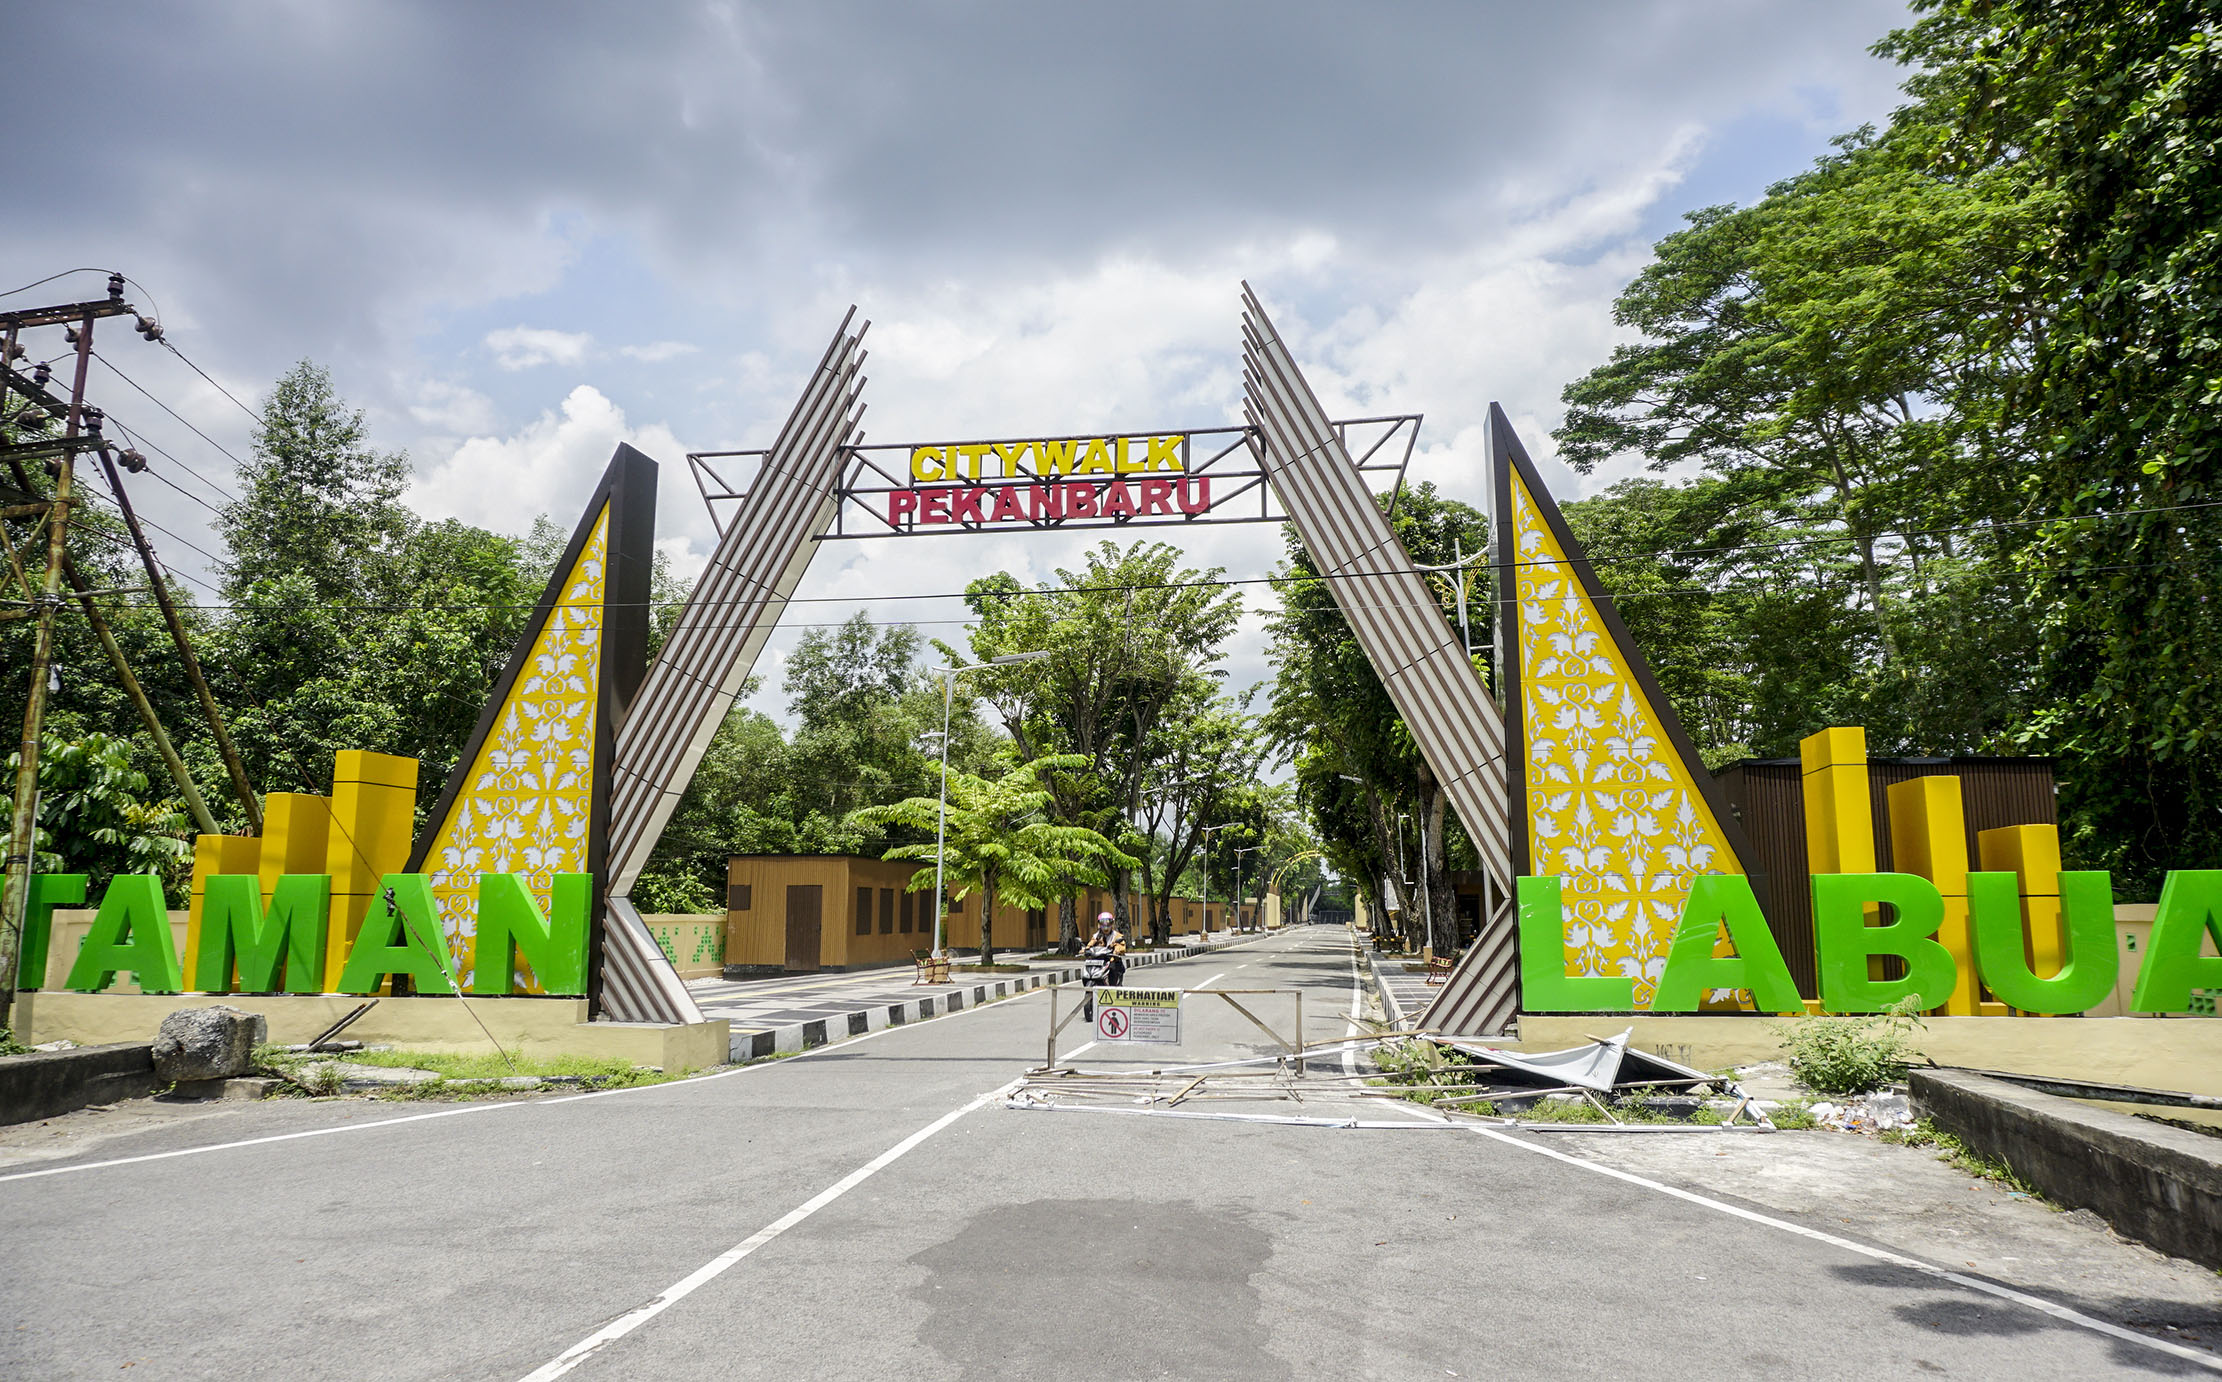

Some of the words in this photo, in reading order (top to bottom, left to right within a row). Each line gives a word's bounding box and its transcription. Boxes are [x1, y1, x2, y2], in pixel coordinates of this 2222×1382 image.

[911, 436, 1185, 482] CITYWALK
[888, 478, 1211, 526] PEKANBARU
[0, 873, 593, 996] TAMAN
[1116, 990, 1175, 1001] PERHATIAN
